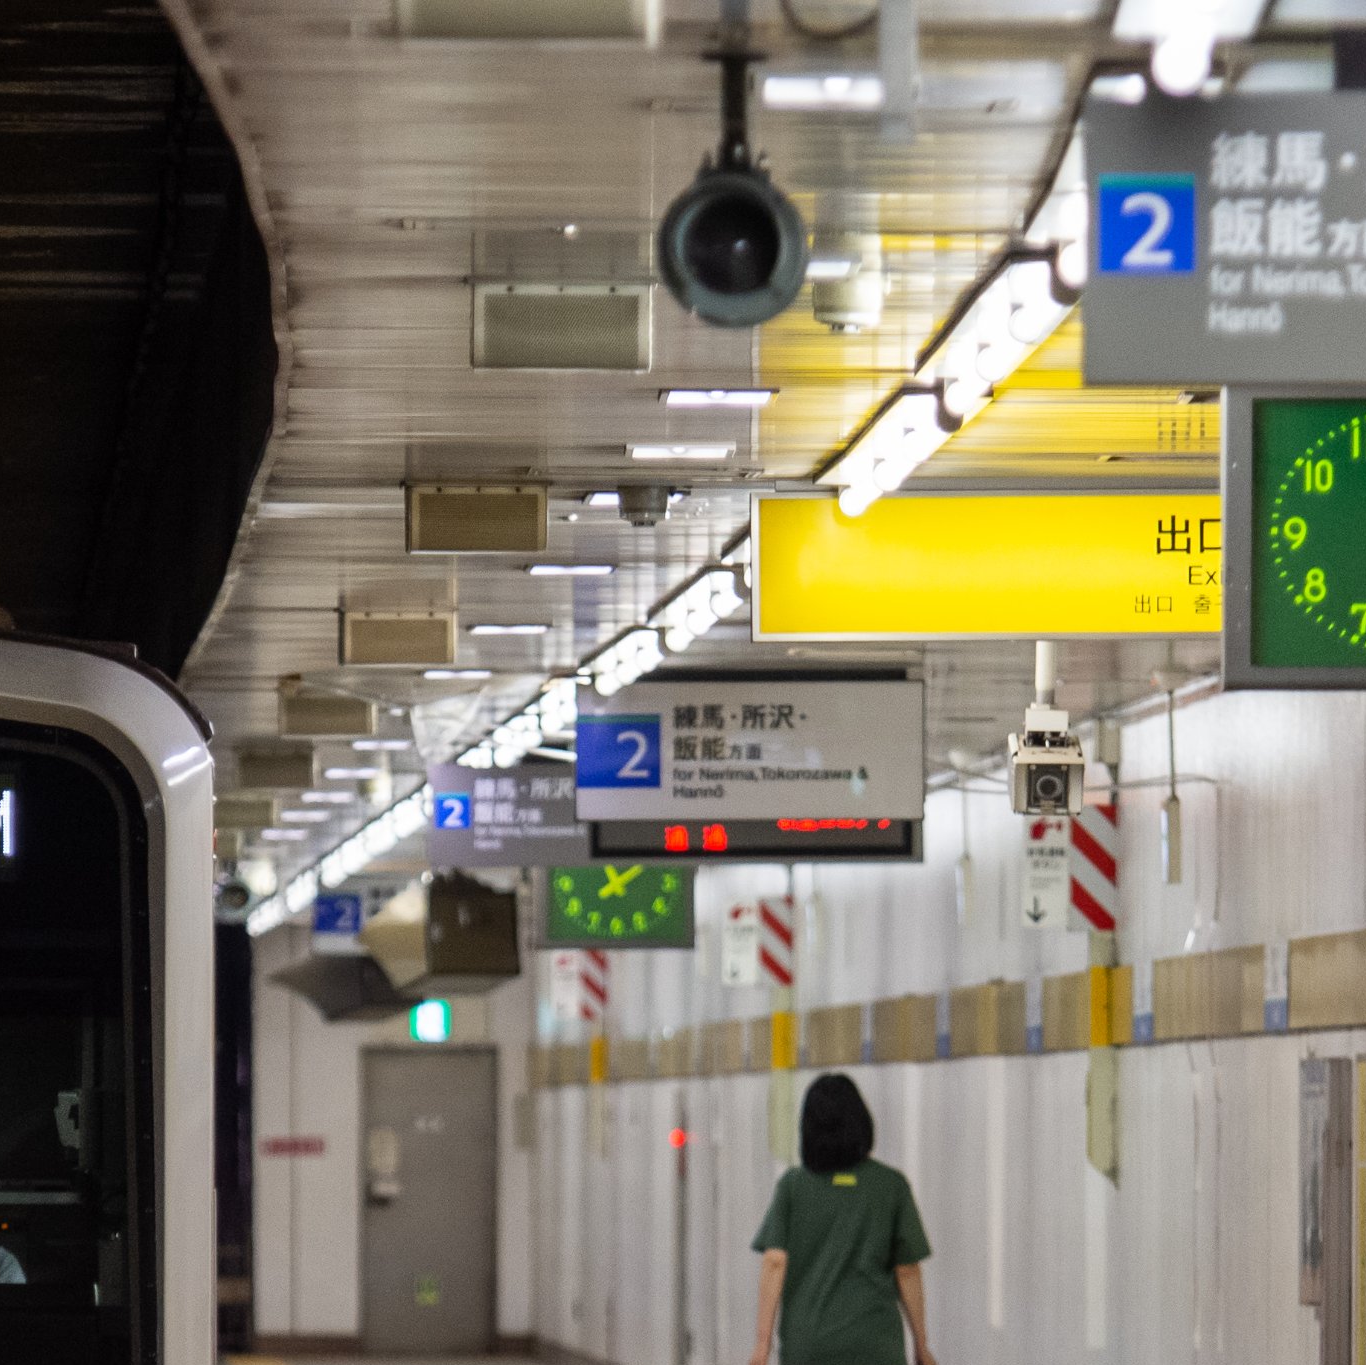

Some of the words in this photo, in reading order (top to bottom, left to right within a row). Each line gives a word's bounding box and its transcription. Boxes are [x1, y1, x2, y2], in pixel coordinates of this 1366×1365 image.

[1119, 191, 1176, 267] 2
[1304, 458, 1334, 493] 10
[1156, 514, 1222, 555] 出口
[1283, 516, 1308, 551] 9
[1188, 565, 1222, 586] Ex
[1303, 567, 1327, 603] 8
[616, 730, 650, 779] 2
[442, 798, 465, 828] 2
